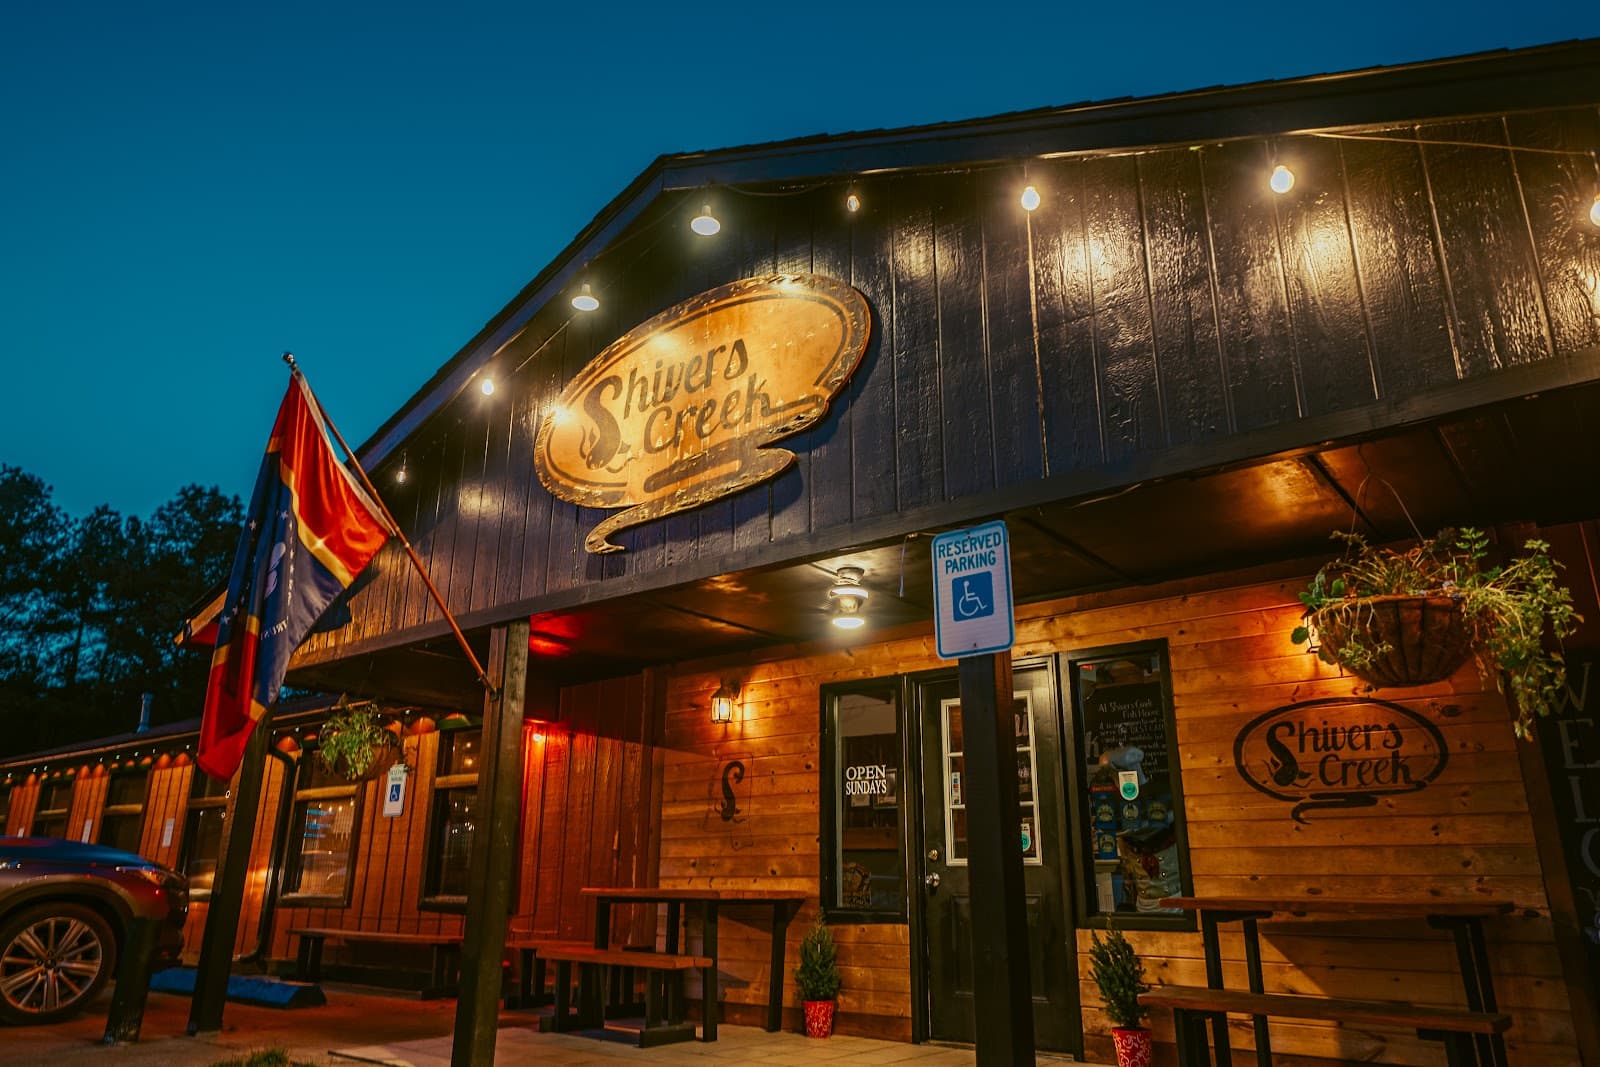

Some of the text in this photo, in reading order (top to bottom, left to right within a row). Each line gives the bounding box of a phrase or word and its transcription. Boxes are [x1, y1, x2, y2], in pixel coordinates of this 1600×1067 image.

[580, 338, 750, 471] Shivers
[643, 373, 782, 455] Creek
[937, 531, 1002, 559] RESERVED
[945, 551, 997, 575] PARKING
[1264, 720, 1403, 787] Shivers
[1319, 750, 1415, 786] Creek
[845, 764, 887, 781] OPEN
[845, 779, 887, 796] SUNDAYS
